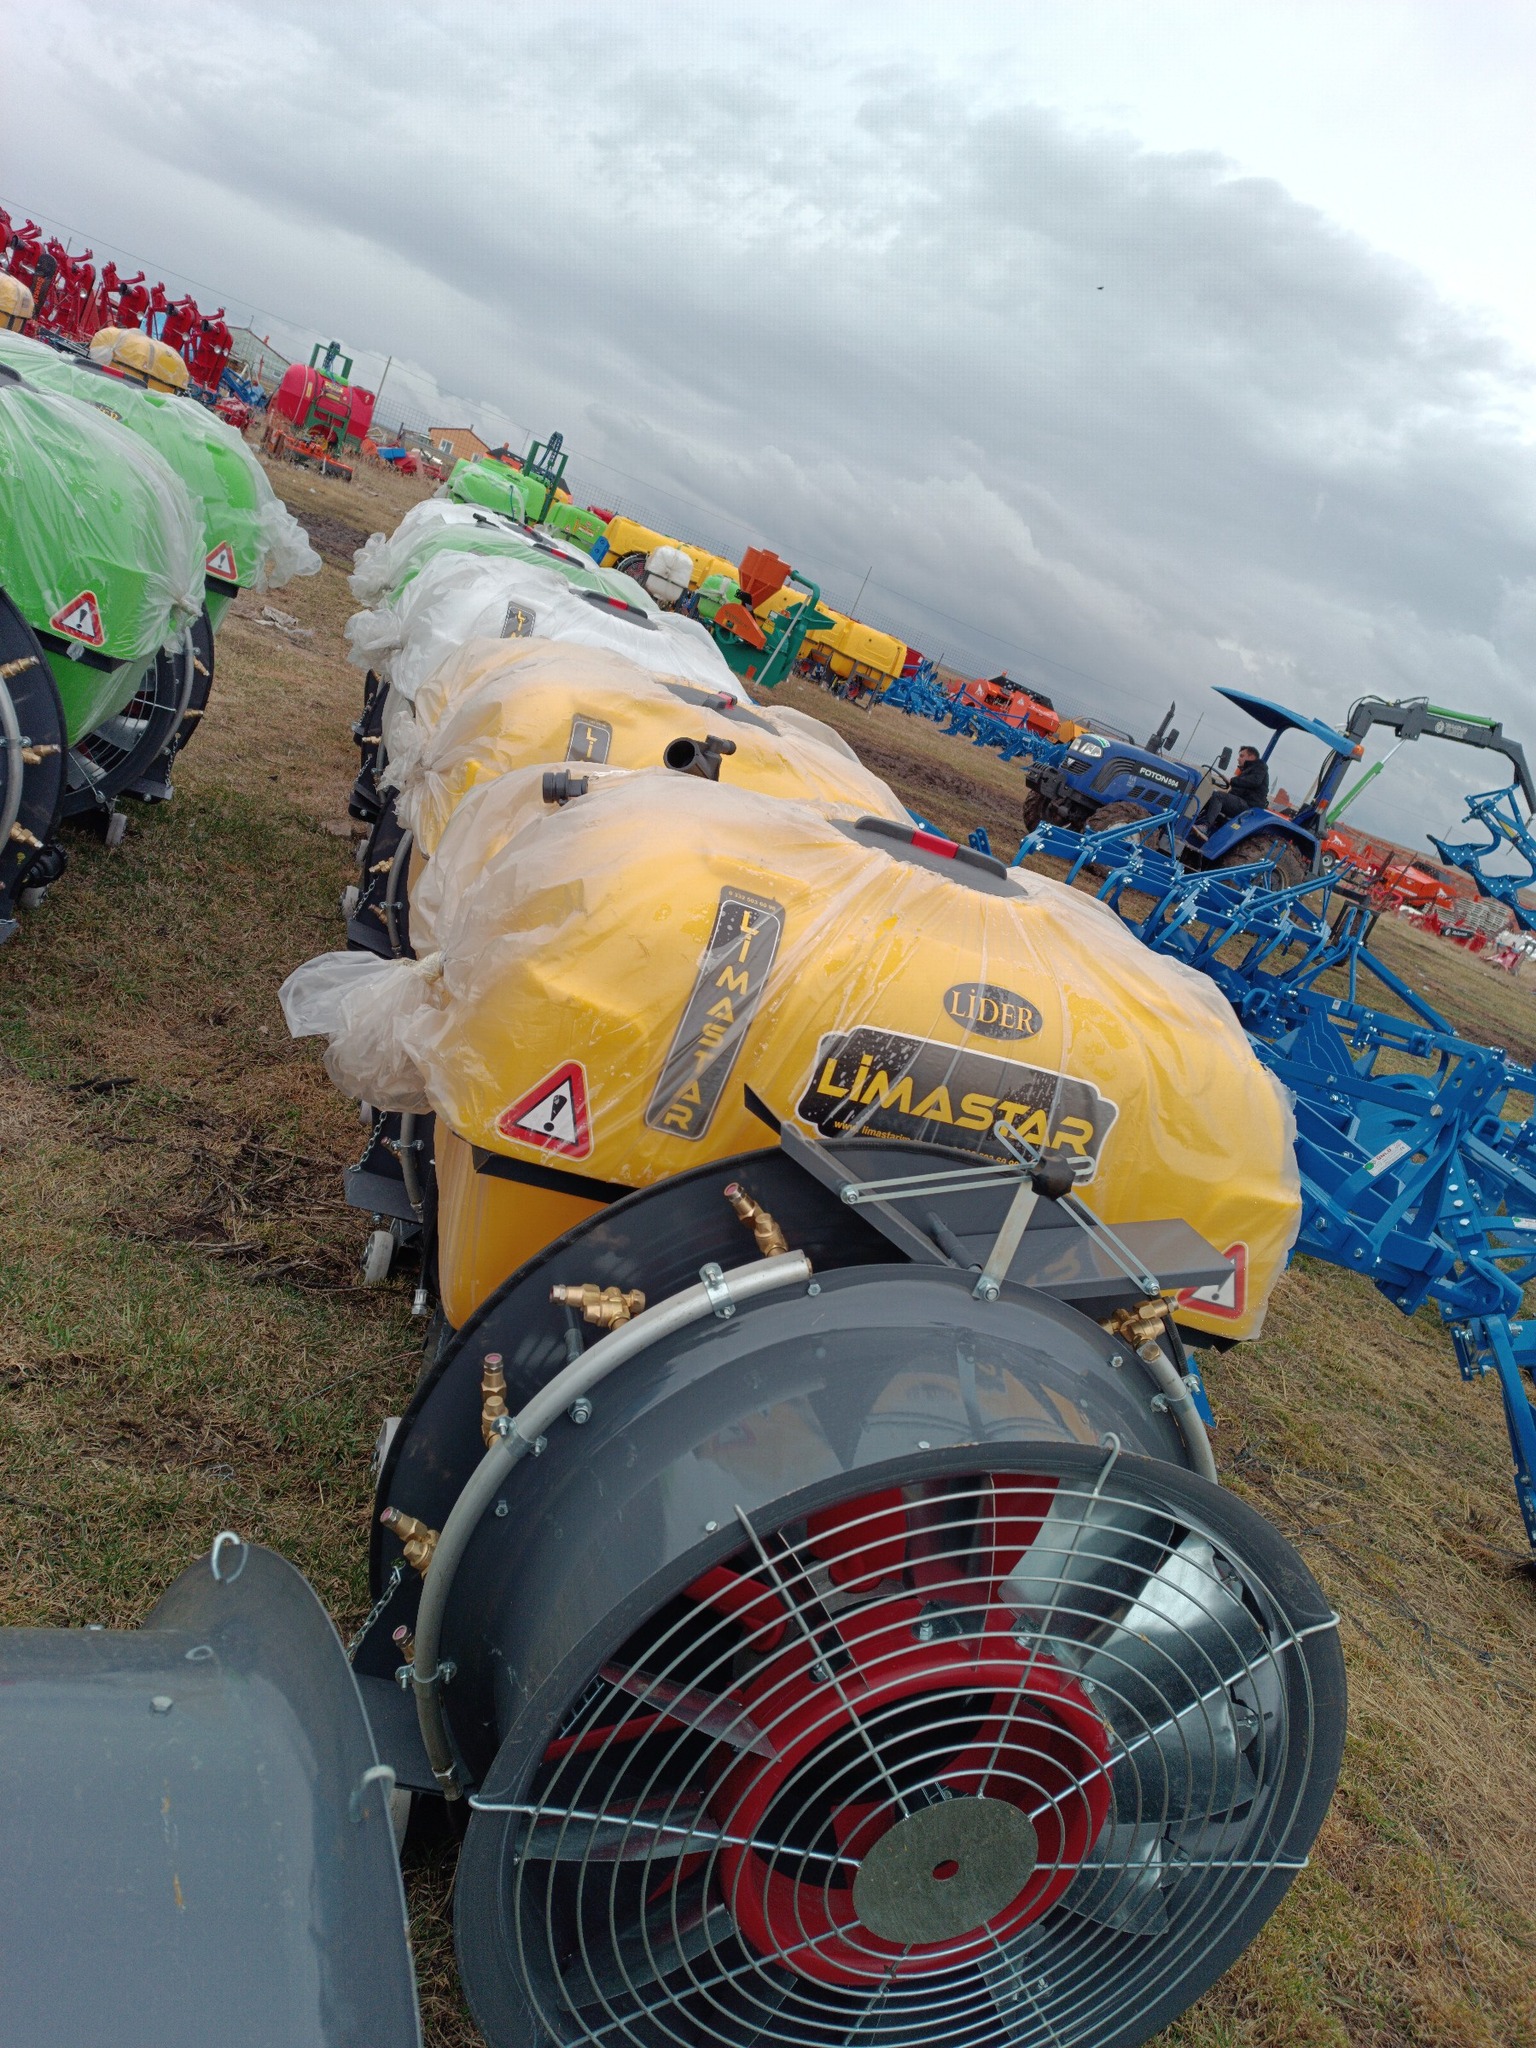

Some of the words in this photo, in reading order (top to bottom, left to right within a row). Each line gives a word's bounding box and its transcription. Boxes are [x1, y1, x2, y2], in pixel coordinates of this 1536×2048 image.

[1139, 766, 1169, 784] FOTON
[663, 910, 759, 1131] LİMASTAR
[950, 988, 1035, 1034] LİDER
[816, 1054, 1094, 1156] LİMASTAR
